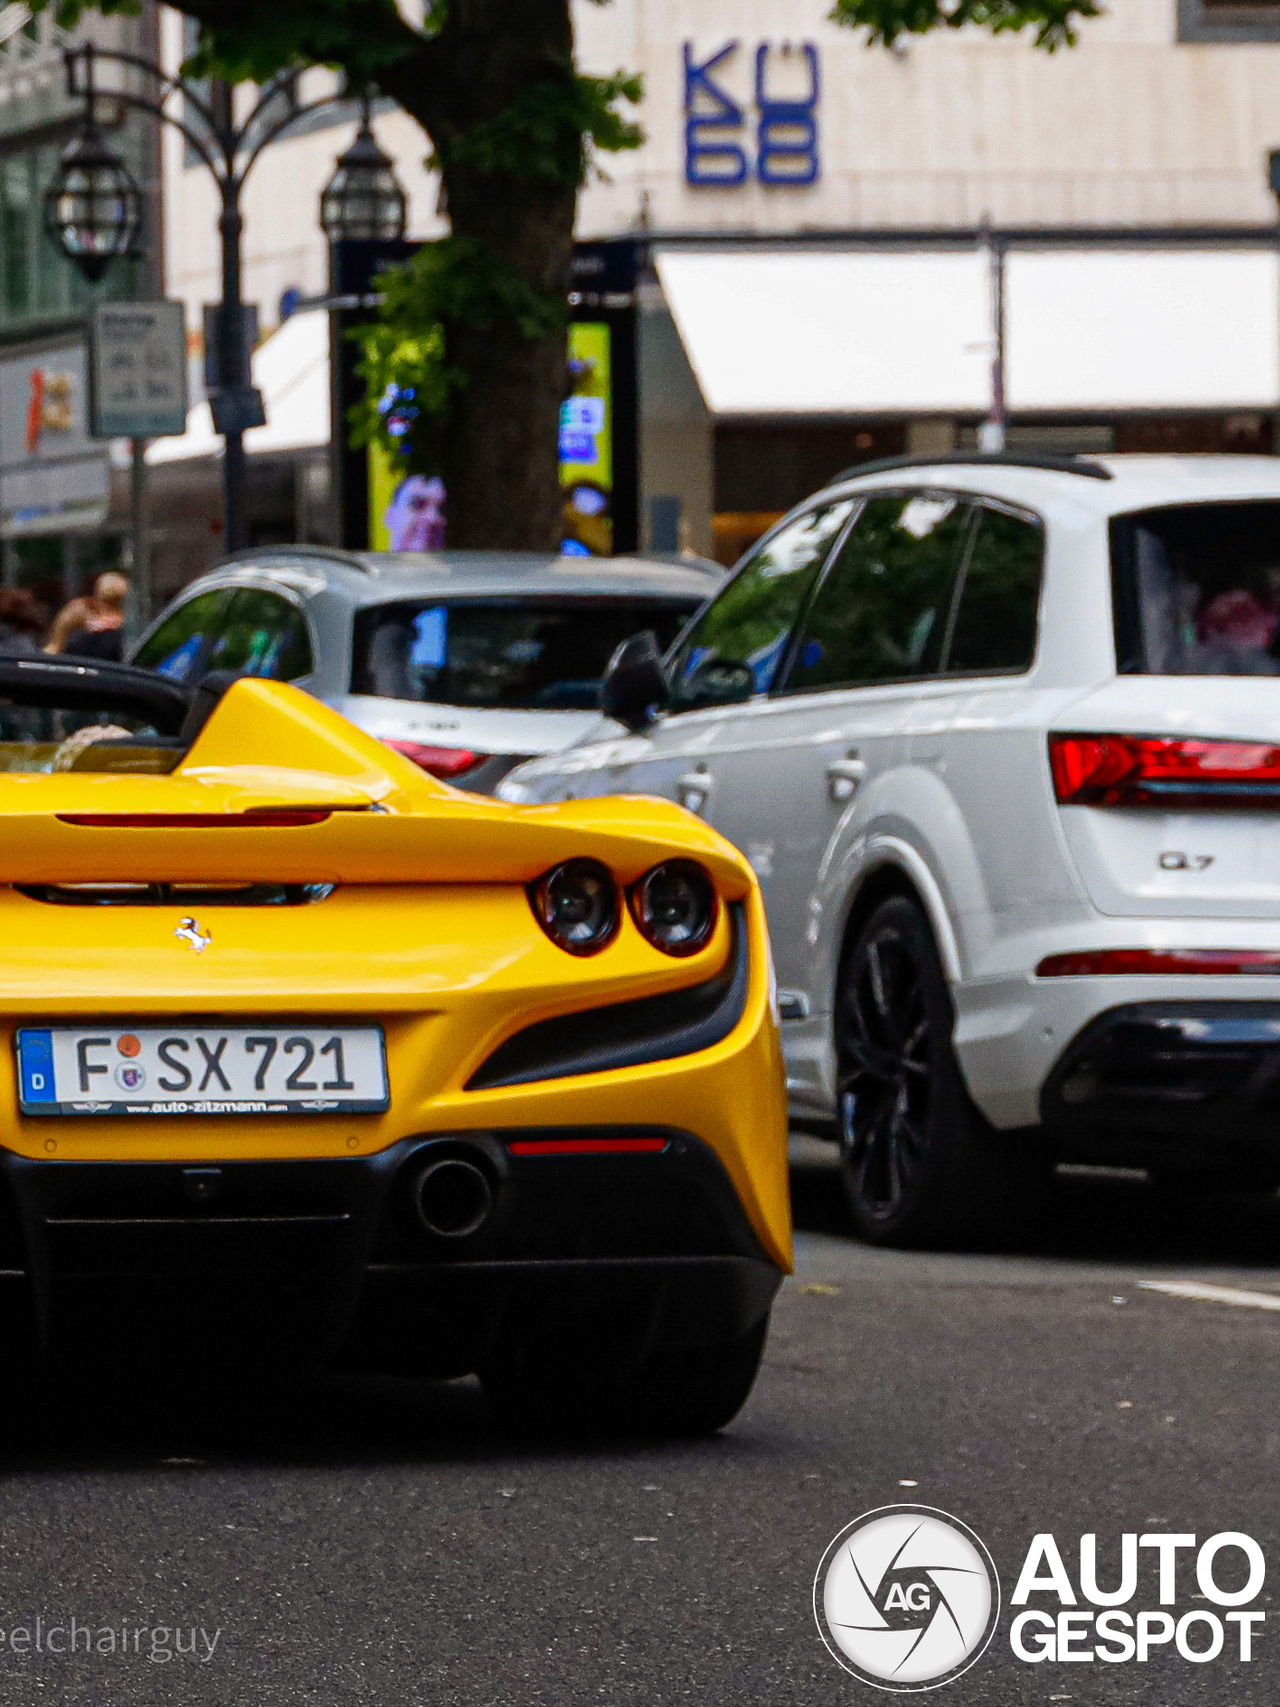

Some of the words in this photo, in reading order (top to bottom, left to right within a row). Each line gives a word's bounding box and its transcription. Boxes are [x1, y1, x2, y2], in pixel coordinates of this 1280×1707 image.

[1158, 851, 1215, 871] Q7
[76, 1037, 112, 1092] F
[157, 1037, 231, 1092] SX
[245, 1037, 354, 1091] 721
[32, 1073, 45, 1090] D
[126, 1101, 289, 1113] www.auto-zitzmann.com
